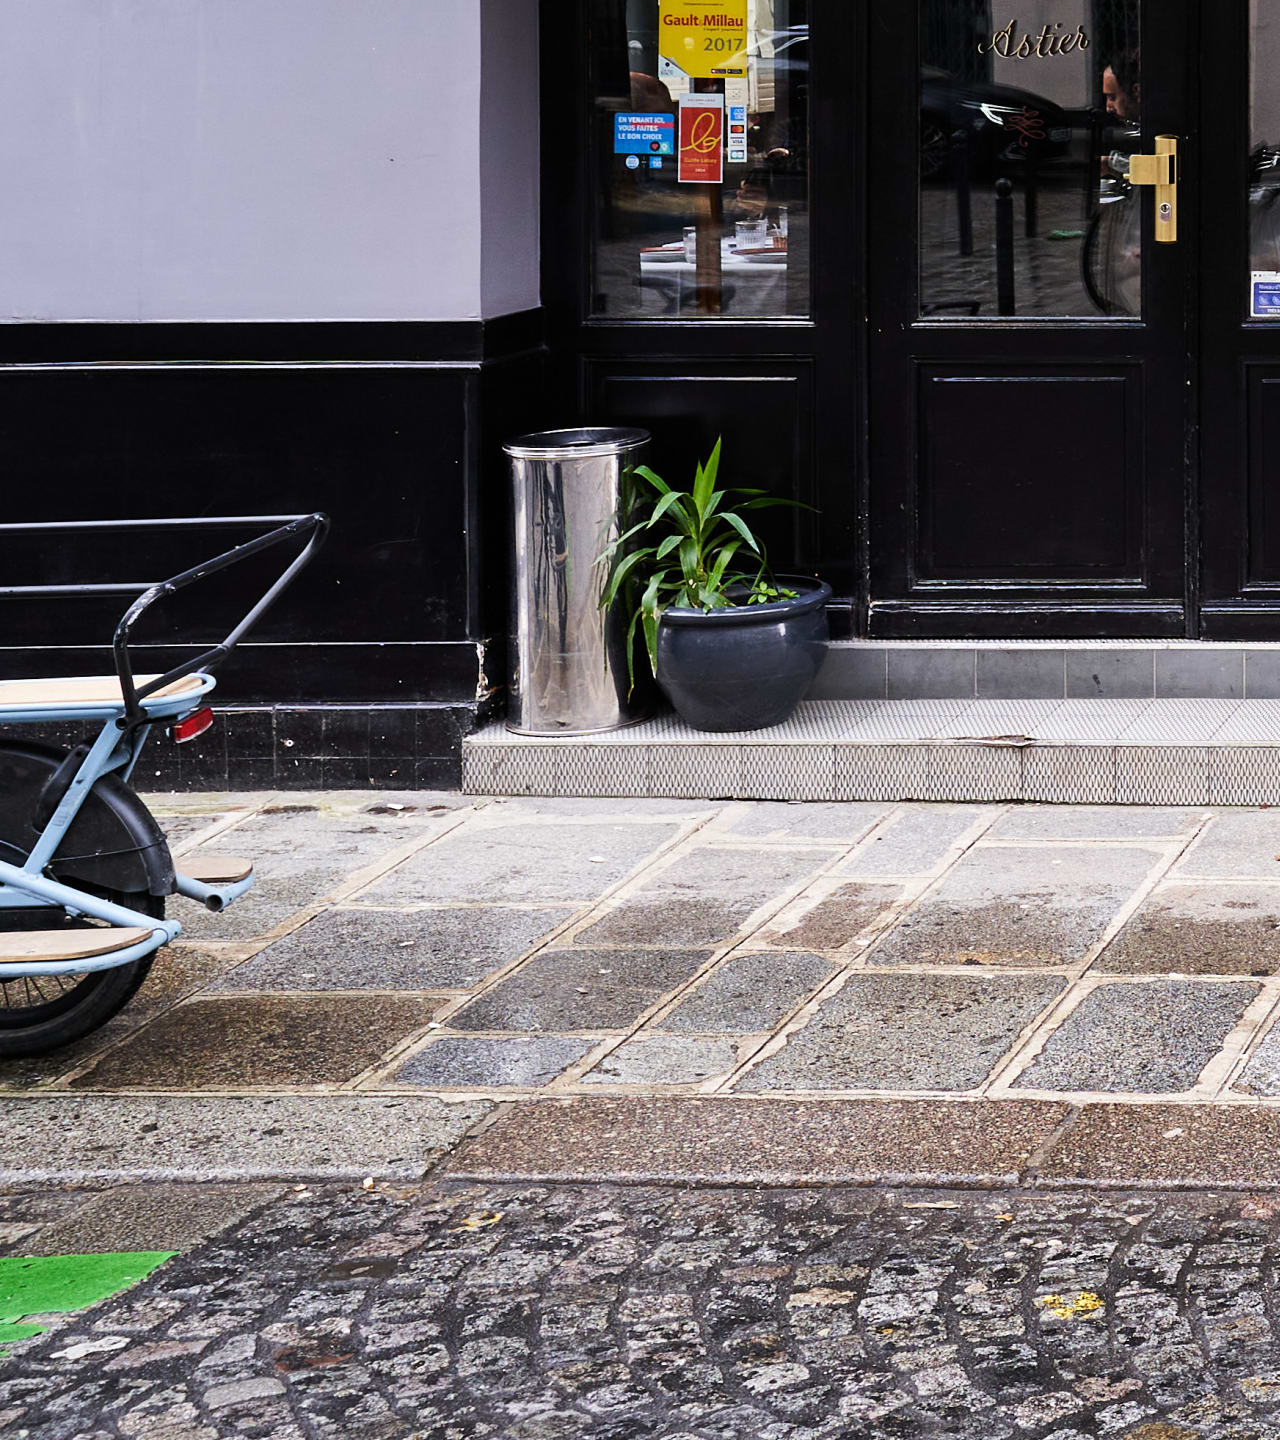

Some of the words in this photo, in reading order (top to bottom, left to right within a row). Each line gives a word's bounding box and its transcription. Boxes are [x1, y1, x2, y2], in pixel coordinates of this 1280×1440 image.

[663, 14, 699, 26] Gault
[703, 14, 744, 27] Millau
[703, 38, 744, 51] 2017
[976, 18, 1089, 60] Astier
